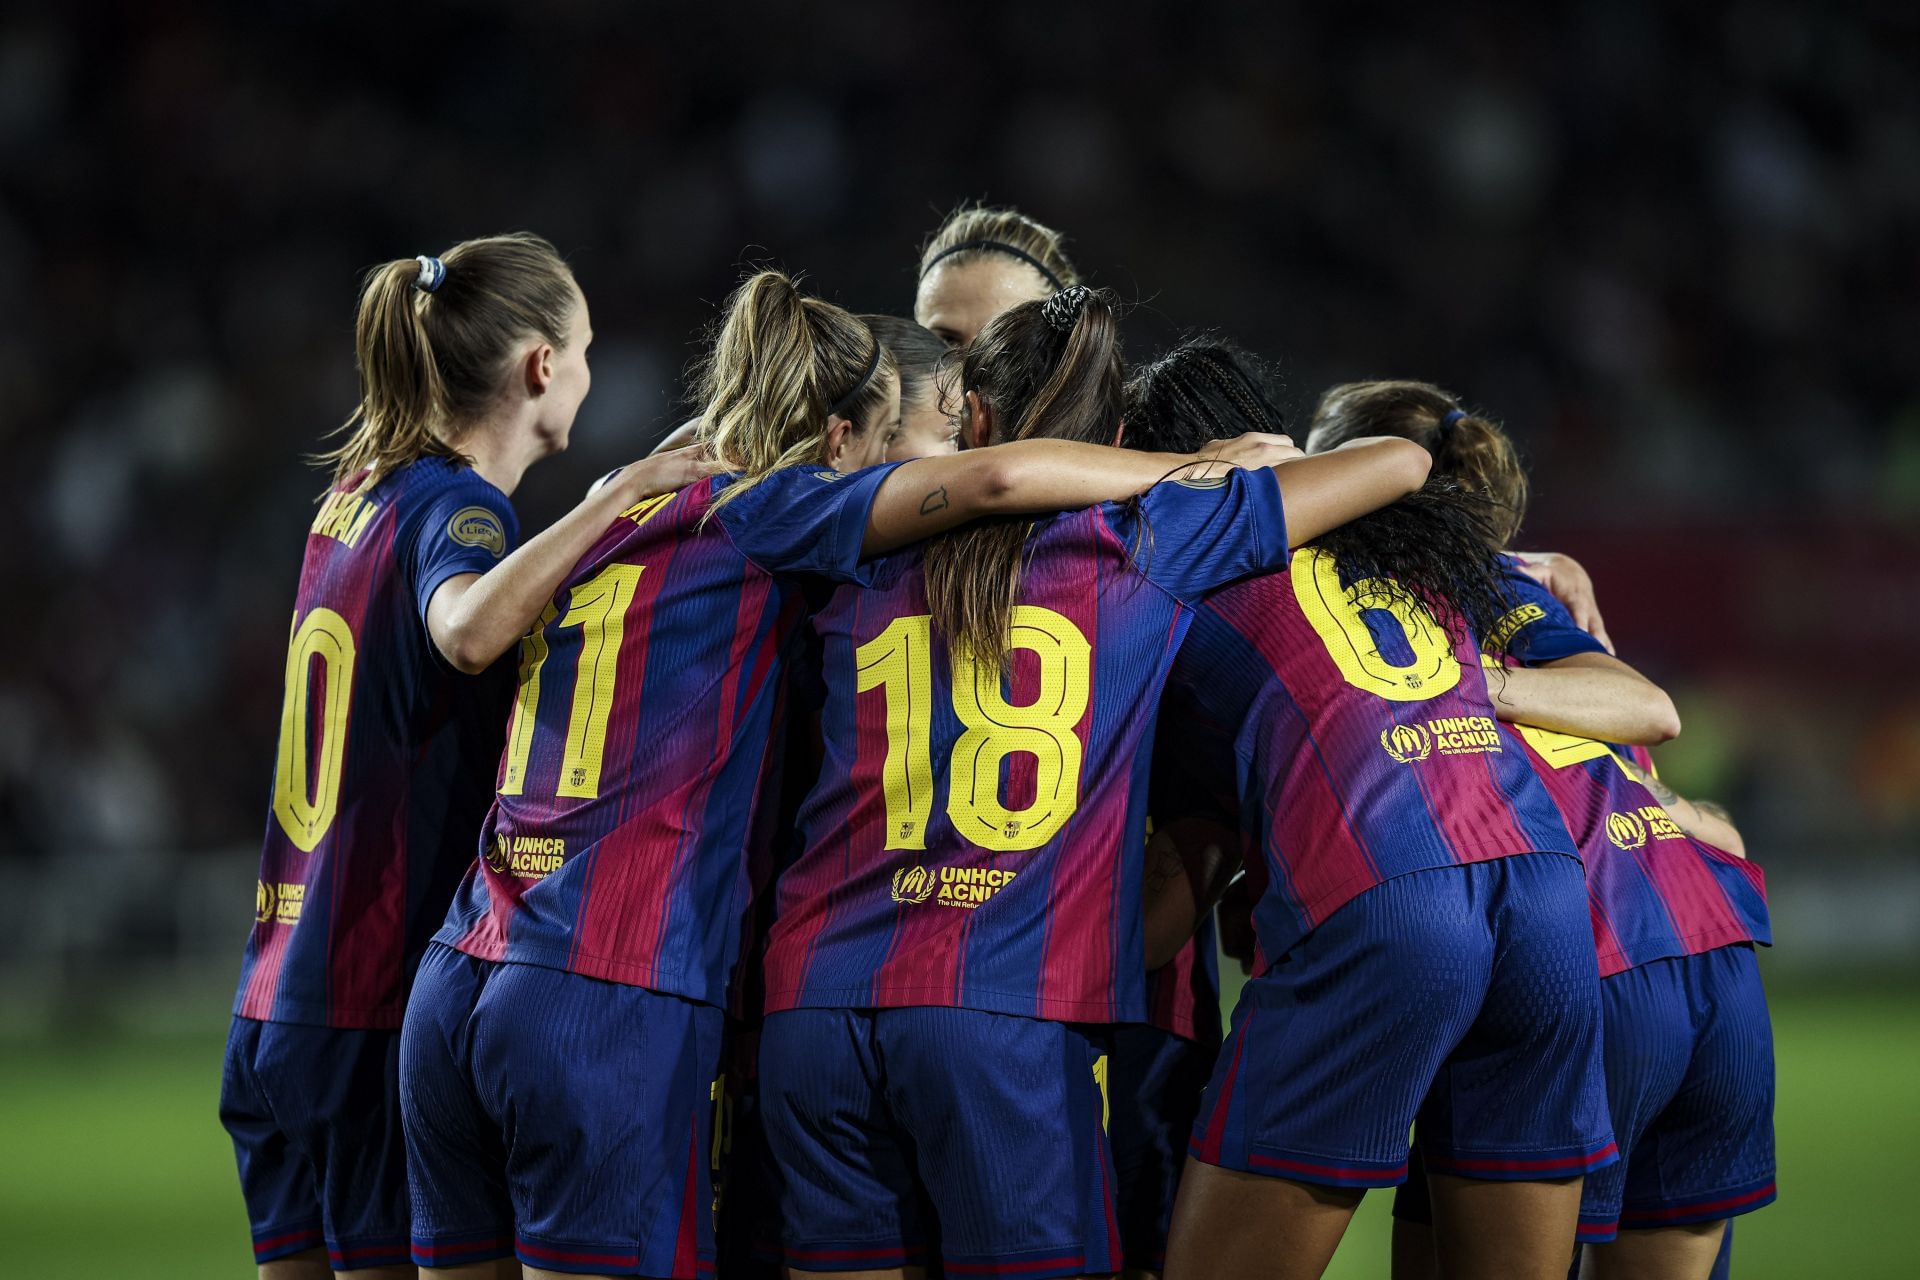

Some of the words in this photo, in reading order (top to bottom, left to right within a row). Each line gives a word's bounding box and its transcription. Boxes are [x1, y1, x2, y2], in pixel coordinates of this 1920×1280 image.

[497, 563, 647, 799] 11
[272, 607, 356, 853] 0
[855, 604, 1093, 852] 18
[1428, 716, 1496, 734] UNHCR
[1438, 731, 1500, 749] ACNUR
[1649, 820, 1681, 835] ACN
[513, 837, 565, 855] UNHCR
[511, 854, 563, 871] ACNUR
